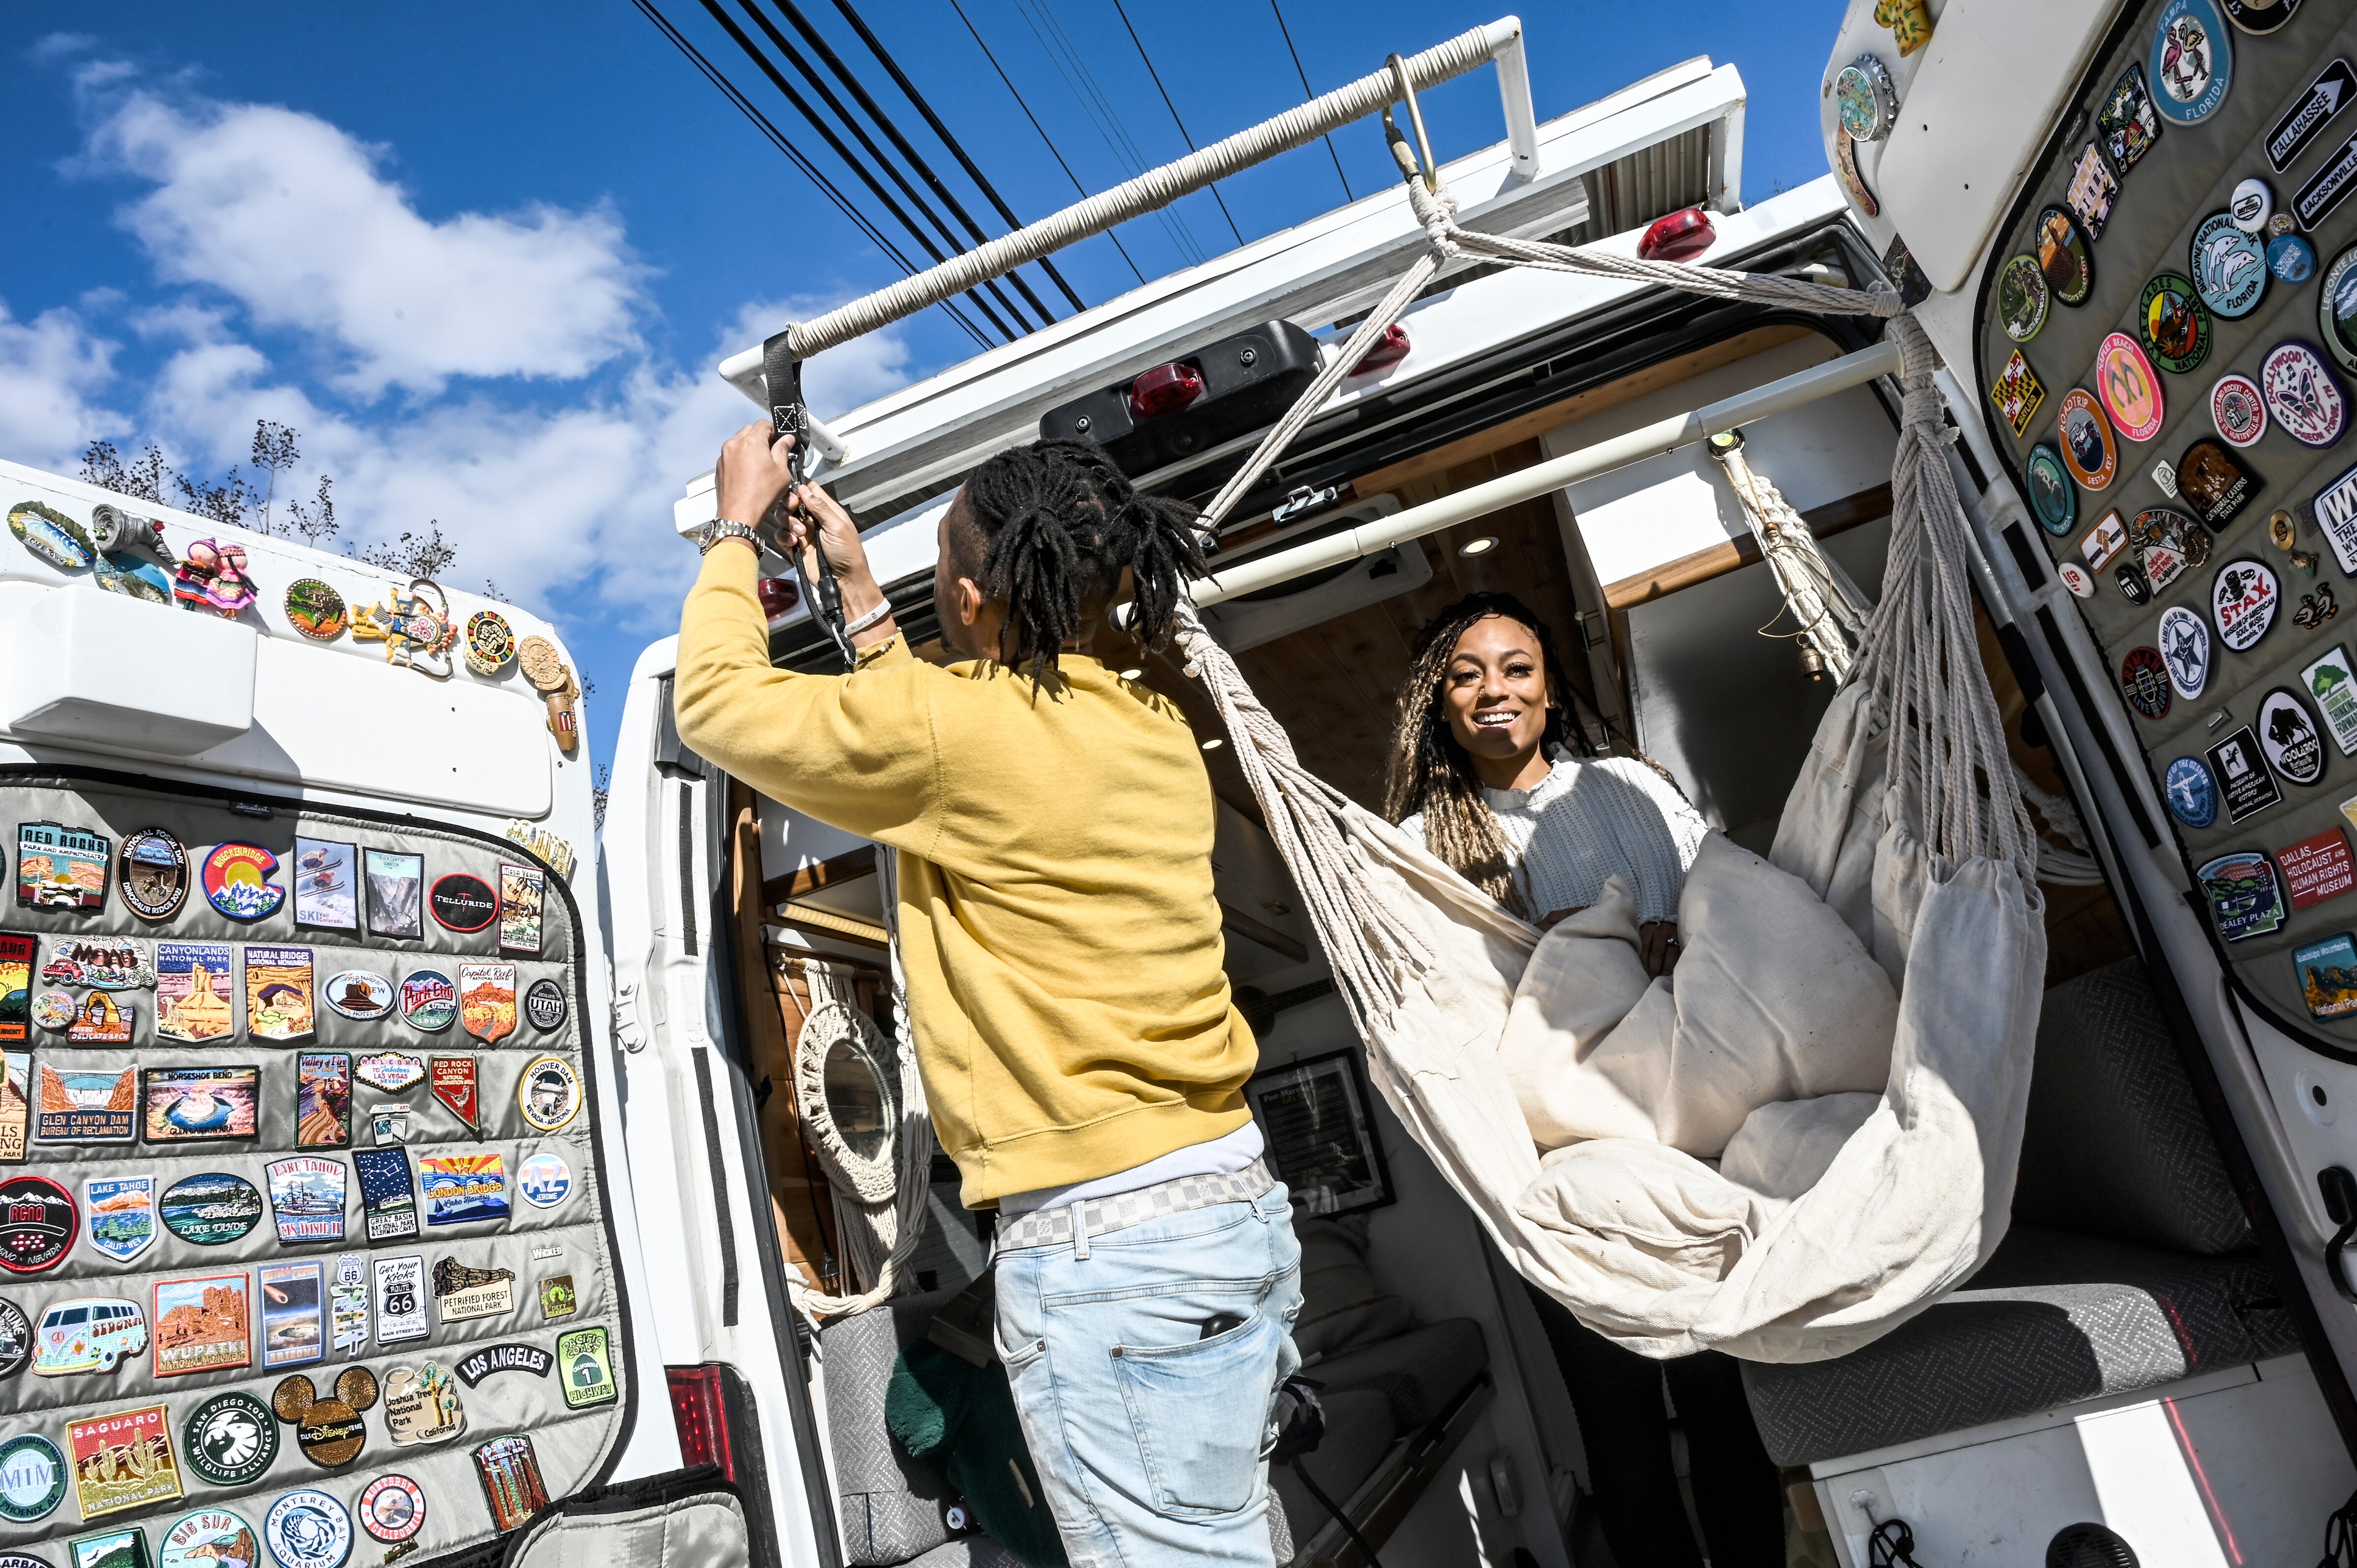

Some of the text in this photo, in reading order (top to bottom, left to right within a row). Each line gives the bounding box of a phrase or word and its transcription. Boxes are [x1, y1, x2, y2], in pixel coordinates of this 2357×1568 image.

[2160, 0, 2187, 33] TAMPA
[2186, 78, 2224, 120] FLORIDA
[2273, 91, 2330, 156] TALLAHASSEE
[2304, 154, 2357, 215] JACKSONVILLE
[2237, 202, 2259, 214] DAYTONA
[2193, 217, 2234, 295] BISCAYNE NATIONAL
[2322, 258, 2348, 310] LECONTE
[2226, 280, 2259, 309] FLORIDA
[2020, 322, 2036, 337] ATLANTA
[2141, 278, 2207, 370] EVERGLADES NATIONAL PARK
[2099, 338, 2134, 372] NAPLES BEACH
[2266, 351, 2302, 405] DOLLYWOOD
[2223, 384, 2259, 411] ROCKET CENTER
[2017, 394, 2037, 428] MARYLAND
[2294, 385, 2335, 442] PIGEON TN
[2132, 418, 2159, 437] FLORIDA
[2087, 474, 2106, 485] SIESTA
[2206, 477, 2247, 521] CATHEDRAL CAVERNS
[2220, 492, 2246, 519] STATE PARK
[2054, 515, 2072, 533] FLORIDA
[2336, 523, 2357, 543] THE
[29, 538, 64, 563] CAPE TOWN
[2157, 562, 2179, 585] ALABAMA
[2220, 572, 2271, 627] STAX
[2224, 596, 2275, 639] MUSEUM AMERICAN
[2236, 613, 2265, 638] SOUL MUSIC
[2329, 697, 2357, 723] THINKING
[2279, 739, 2318, 764] WOOLAROC
[2189, 760, 2208, 784] OZARKS
[2242, 775, 2266, 793] AMERICAN
[2238, 788, 2257, 802] HISTORY
[25, 829, 104, 853] RED ROCKS
[123, 829, 177, 859] NATIONAL FOSSIL
[213, 847, 266, 868] BRECKENRIDGE
[2280, 846, 2312, 866] DALLAS
[2286, 849, 2345, 878] HOLOCAUST AND
[2292, 862, 2349, 892] HUMAN RIGHTS
[2317, 875, 2352, 896] MUSEUM
[123, 882, 172, 914] DINOSAUR RIDGE
[435, 894, 493, 909] TELLURIDE
[299, 910, 319, 922] SKI
[2220, 916, 2247, 930] DEALEY
[2250, 908, 2279, 922] PLAZA
[71, 943, 138, 969] MOAB
[159, 946, 229, 955] CANYONLANDS
[247, 950, 309, 960] NATURAL BRIDGES
[462, 967, 514, 980] Capitol Reef
[531, 998, 562, 1013] UTAH
[2315, 1000, 2345, 1016] National
[301, 1056, 323, 1069] Valley
[168, 1071, 233, 1081] HORSESHOE BEND
[530, 1062, 573, 1084] HOOVER DAM
[42, 1114, 129, 1126] GLEN CANYON DAM
[547, 1108, 571, 1125] ARIZONA
[40, 1126, 129, 1136] BUREAU RECLAMATION
[272, 1159, 341, 1177] LAKE TAHOE
[91, 1181, 148, 1194] LAKE TAHOE
[527, 1164, 565, 1194] AZ
[427, 1182, 503, 1199] LONDON BRIDGE
[535, 1192, 558, 1201] JEROME
[444, 1198, 463, 1207] Lake
[180, 1222, 247, 1235] LAKE TAHOE
[371, 1217, 392, 1225] GREAT
[27, 1243, 62, 1265] NEVADA
[345, 1271, 357, 1281] 66
[379, 1262, 418, 1275] Get Your
[385, 1271, 416, 1283] Kicks
[390, 1284, 410, 1293] ROUTE
[389, 1295, 413, 1313] 66
[444, 1291, 508, 1308] PETRIFIED FOREST
[452, 1300, 502, 1315] NATIONAL PARK
[93, 1318, 142, 1337] SEDONA
[160, 1343, 246, 1361] WUPATKI
[562, 1333, 604, 1352] PACIFIC
[566, 1342, 599, 1359] COAST
[161, 1358, 198, 1371] NATIONAL
[269, 1347, 318, 1362] ARIZONA
[462, 1347, 546, 1380] LOS ANGELES
[572, 1362, 599, 1373] CALIFORNIA
[387, 1389, 433, 1407] Joshua Tree
[569, 1383, 611, 1402] HIGHWAY
[210, 1398, 265, 1420] DIEGO ZOO
[389, 1402, 422, 1418] National
[74, 1412, 159, 1438] SAGUARO
[392, 1416, 412, 1427] Park
[425, 1424, 456, 1438] California
[192, 1429, 273, 1478] WILDLIFE ALLIANCE
[476, 1437, 528, 1464] YOSEMITE
[87, 1483, 174, 1511] NATIONAL PARK
[366, 1476, 413, 1500] MONTEREY
[271, 1496, 335, 1527] MONTEREY
[171, 1515, 232, 1545] BIG SUR
[371, 1511, 423, 1540] CALIFORNIA
